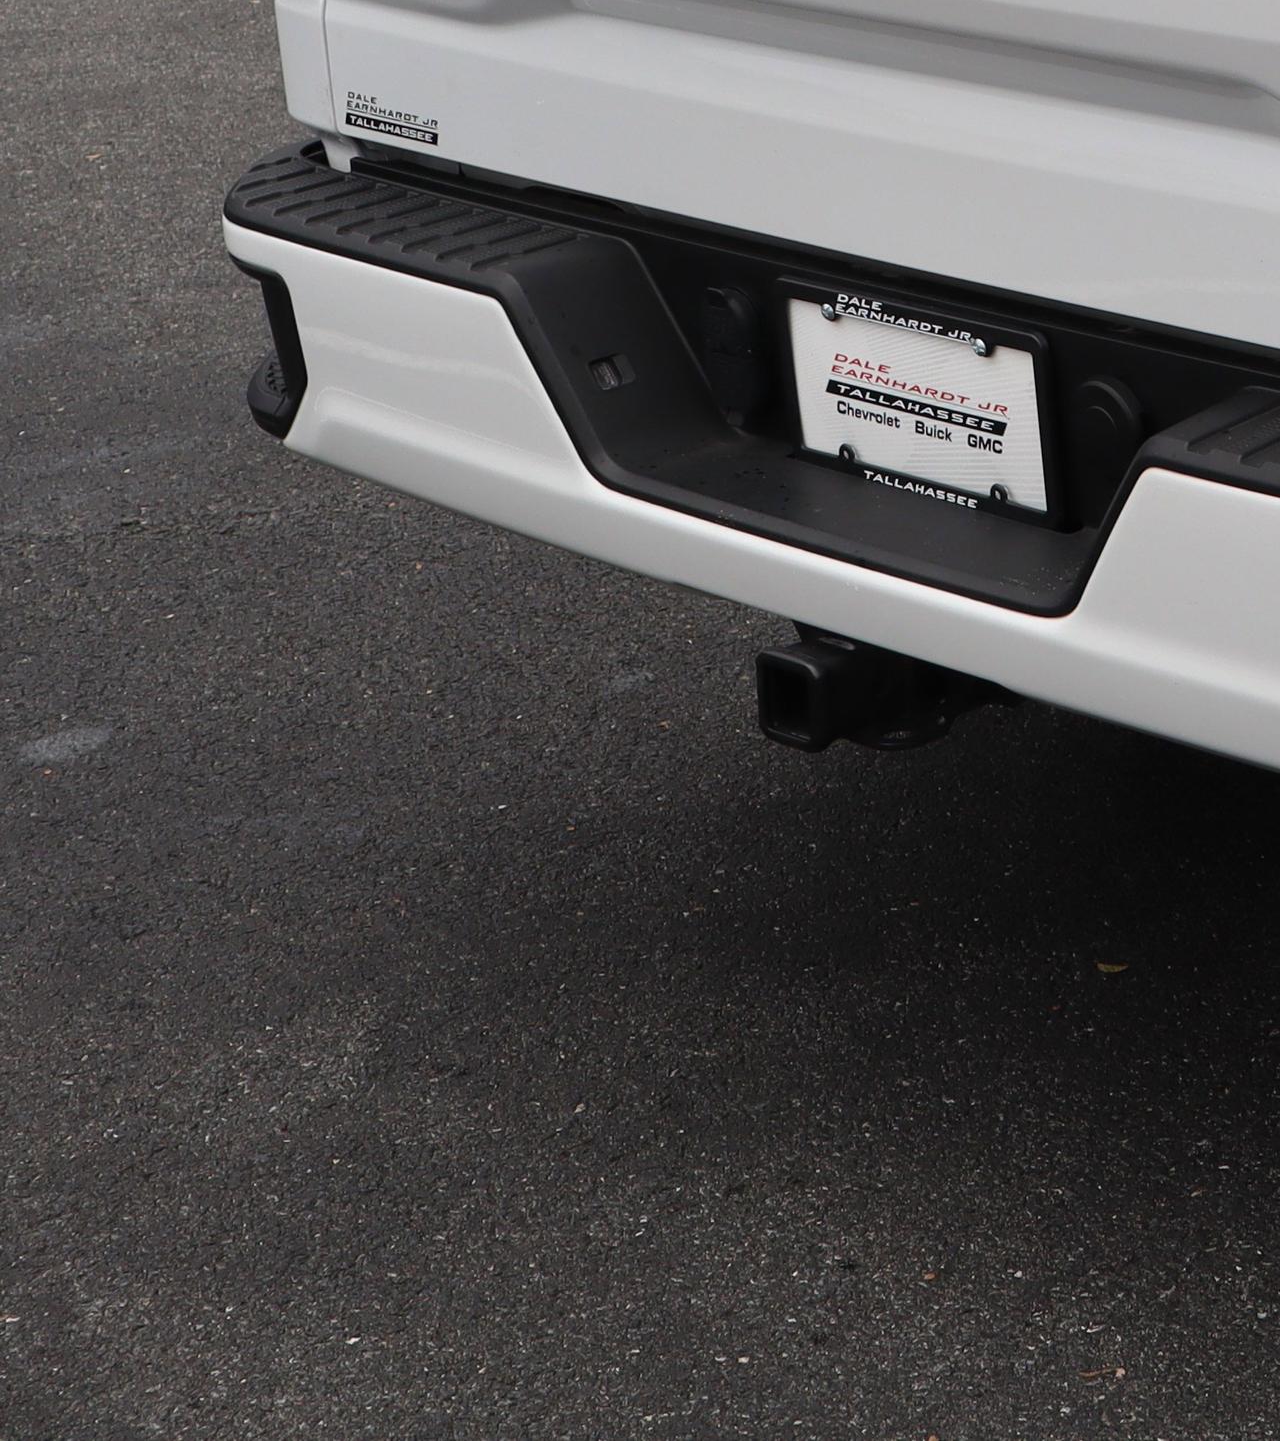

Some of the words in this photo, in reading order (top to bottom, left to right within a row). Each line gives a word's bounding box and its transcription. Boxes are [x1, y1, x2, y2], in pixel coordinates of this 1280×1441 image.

[347, 91, 377, 105] DALE
[347, 100, 419, 123] EARNHARDT
[422, 118, 439, 128] JR
[349, 115, 434, 142] TALLAHASSEE
[836, 293, 882, 311] DALE
[835, 303, 943, 334] EARNHARDT
[834, 353, 891, 374] DALE
[831, 365, 970, 405] EARNHARDT
[977, 401, 1009, 417] JR
[837, 384, 995, 431] TALLAHASSEE
[837, 401, 901, 429] Chevrolet
[914, 420, 953, 442] Buick
[967, 434, 1003, 454] GMC
[863, 470, 978, 509] TALLAHASSEE
